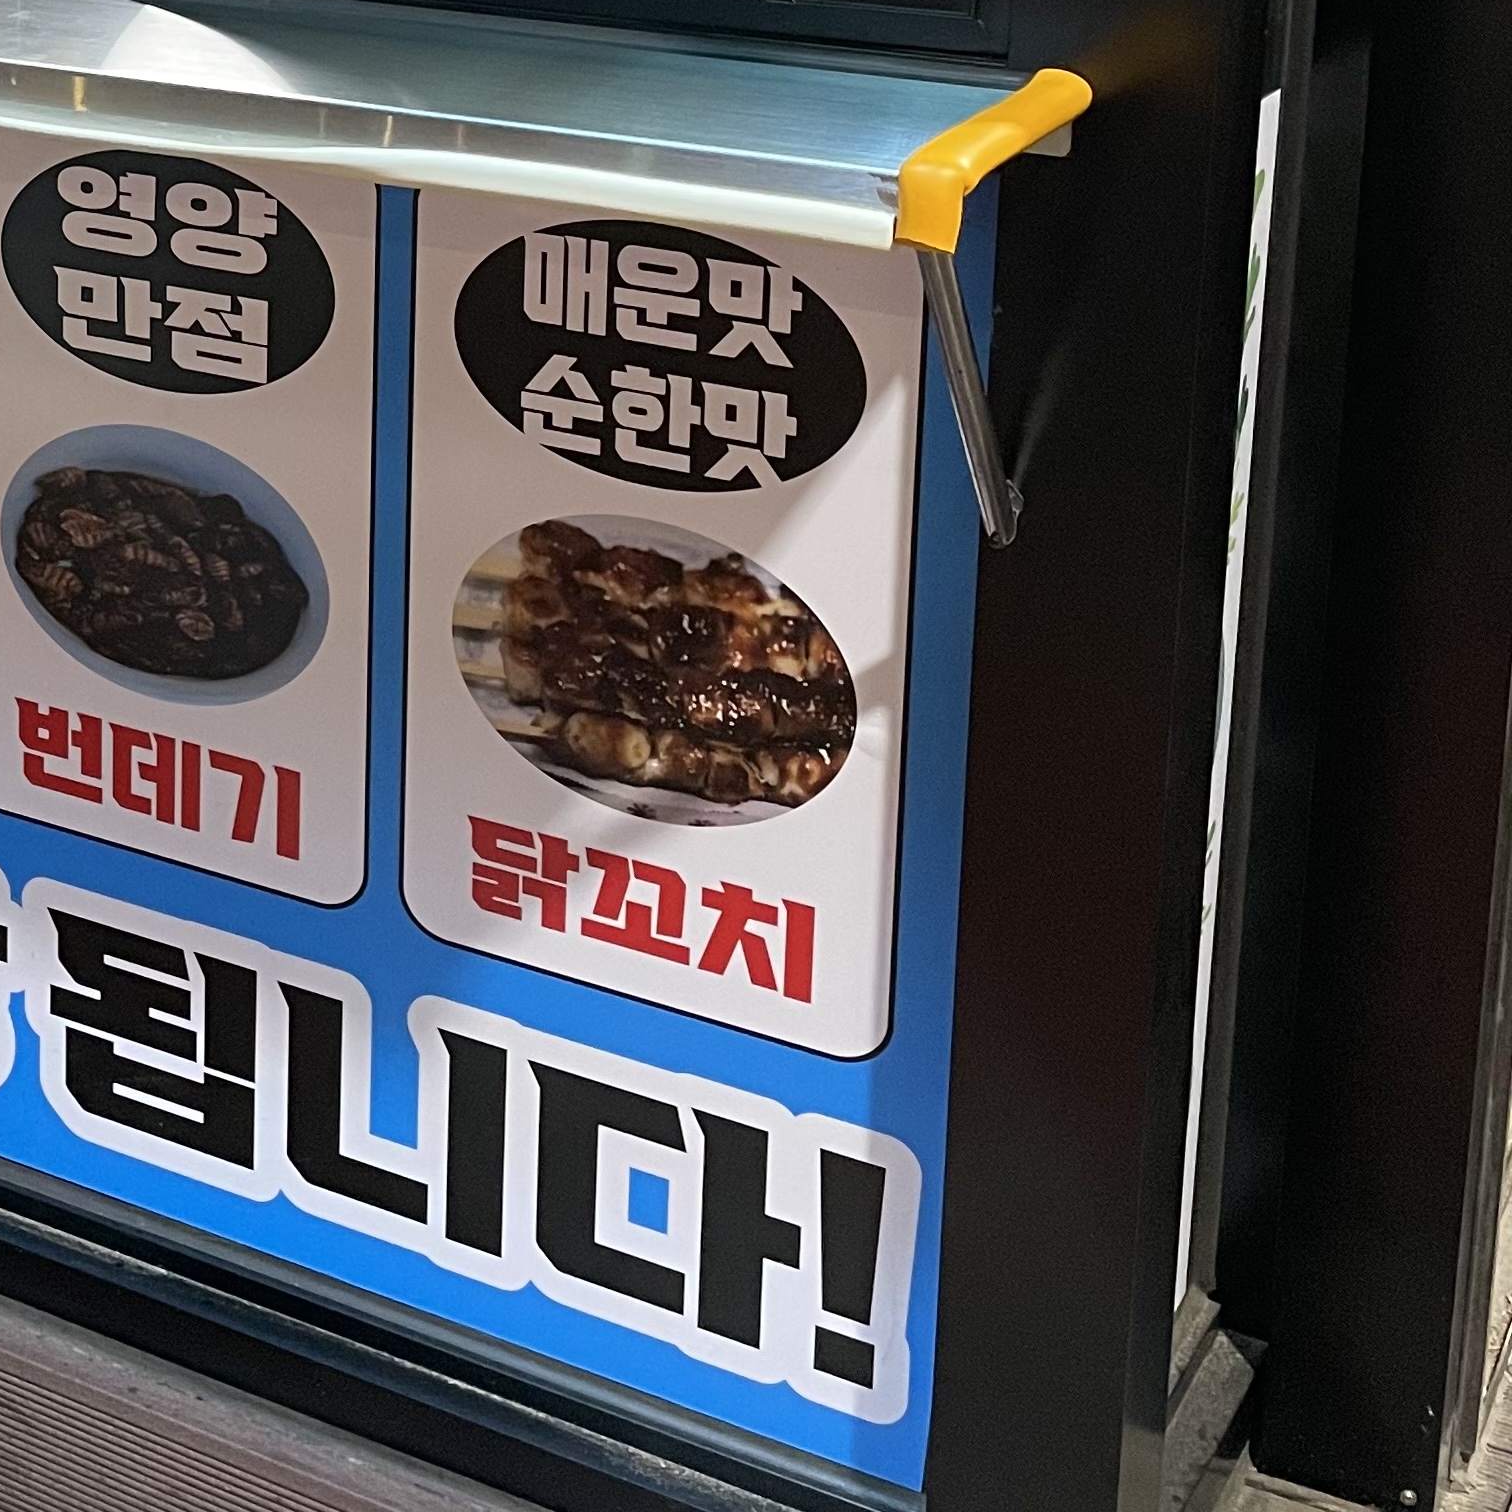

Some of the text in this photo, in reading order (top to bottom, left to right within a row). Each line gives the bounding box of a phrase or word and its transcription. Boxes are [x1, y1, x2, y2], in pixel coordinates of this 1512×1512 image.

[57, 166, 278, 274] 영양
[54, 266, 269, 385] 만점
[522, 232, 803, 367] 매운맛
[521, 356, 797, 483] 순한맛
[15, 697, 300, 861] 번데기
[469, 816, 815, 1004] 닭꼬치
